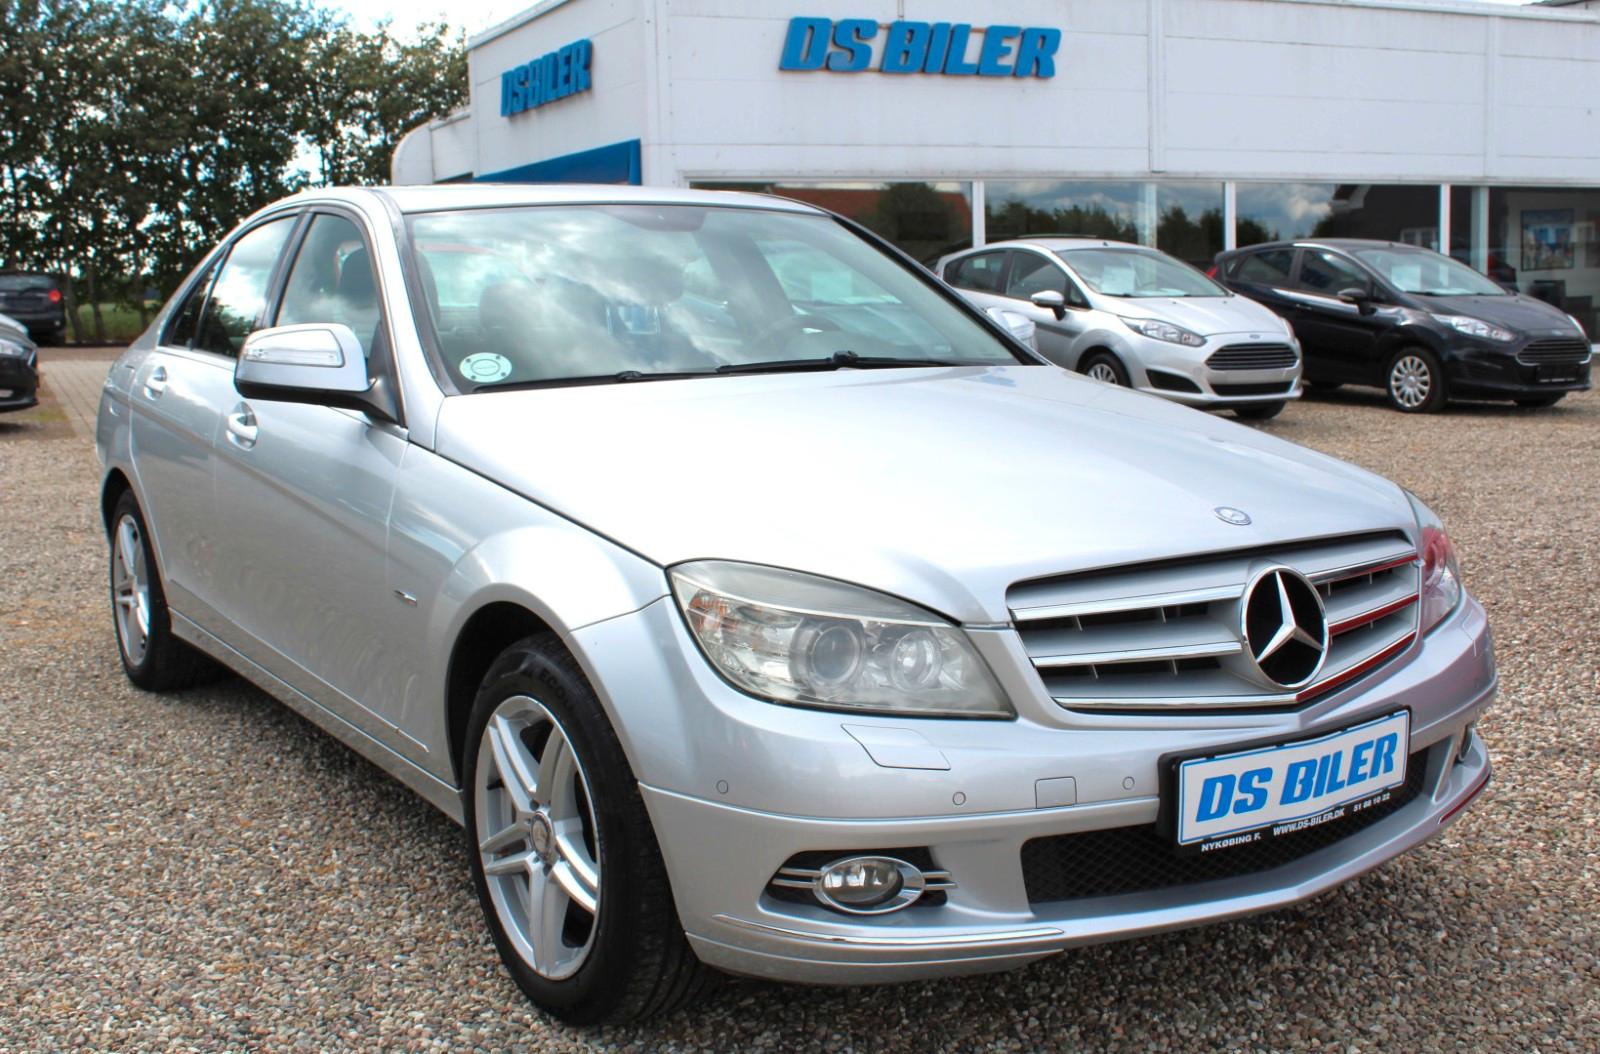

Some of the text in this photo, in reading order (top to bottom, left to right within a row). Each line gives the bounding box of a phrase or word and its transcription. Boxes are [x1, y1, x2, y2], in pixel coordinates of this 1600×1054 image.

[779, 16, 1061, 78] DS BILER
[1195, 732, 1398, 823] DS BILER
[1272, 807, 1346, 837] WWW.DS-BILER.DK
